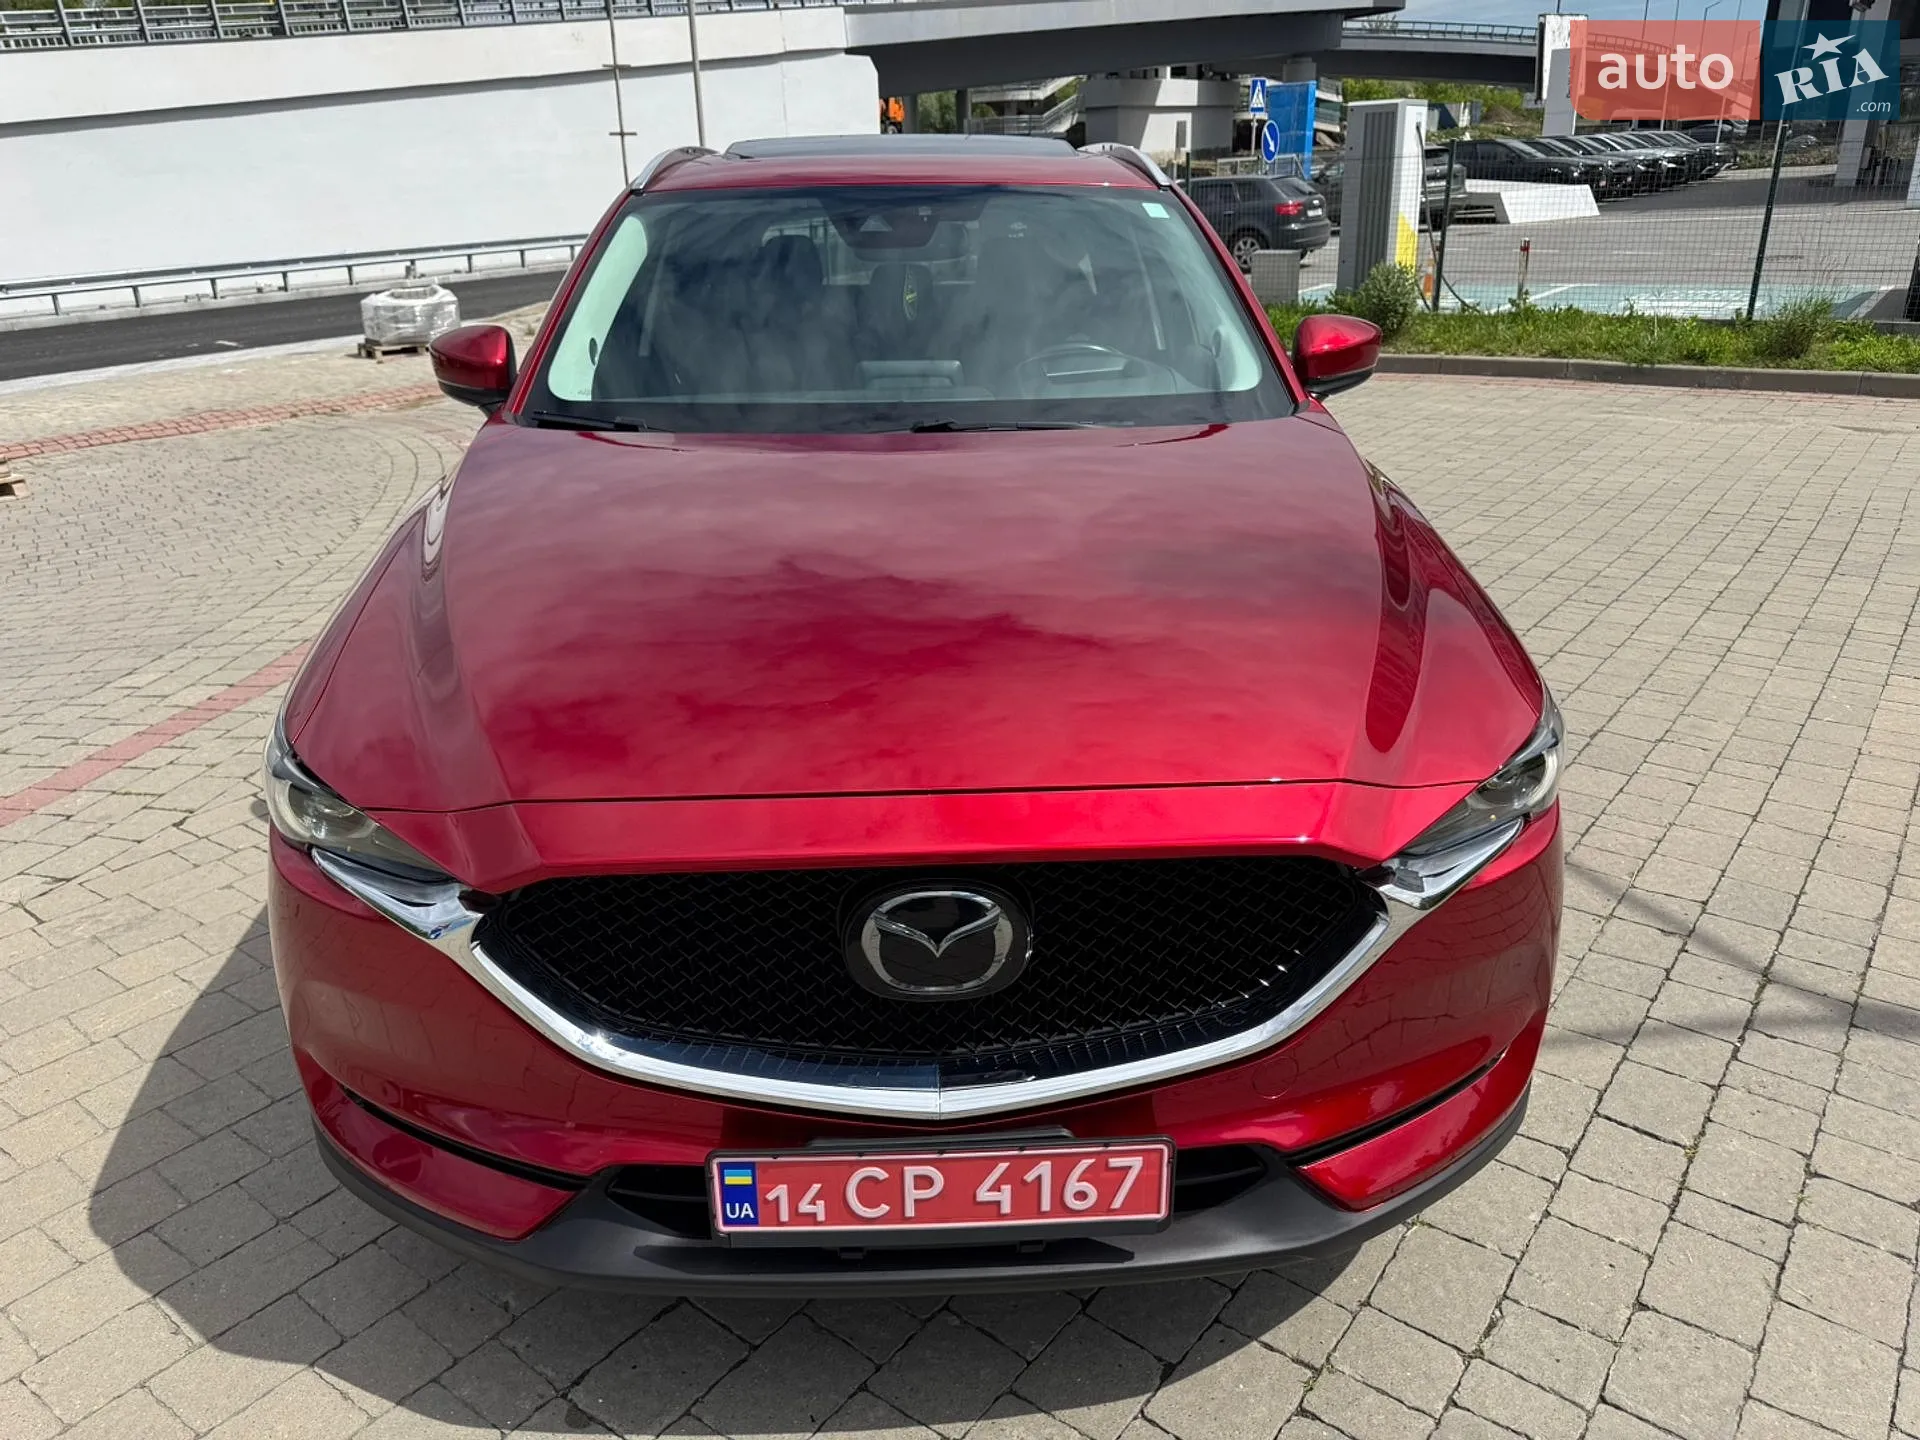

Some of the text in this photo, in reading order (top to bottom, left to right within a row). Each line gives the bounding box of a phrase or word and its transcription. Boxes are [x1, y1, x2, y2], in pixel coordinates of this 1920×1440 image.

[764, 1155, 1144, 1223] 14 CP 4167
[726, 1202, 755, 1220] UA
